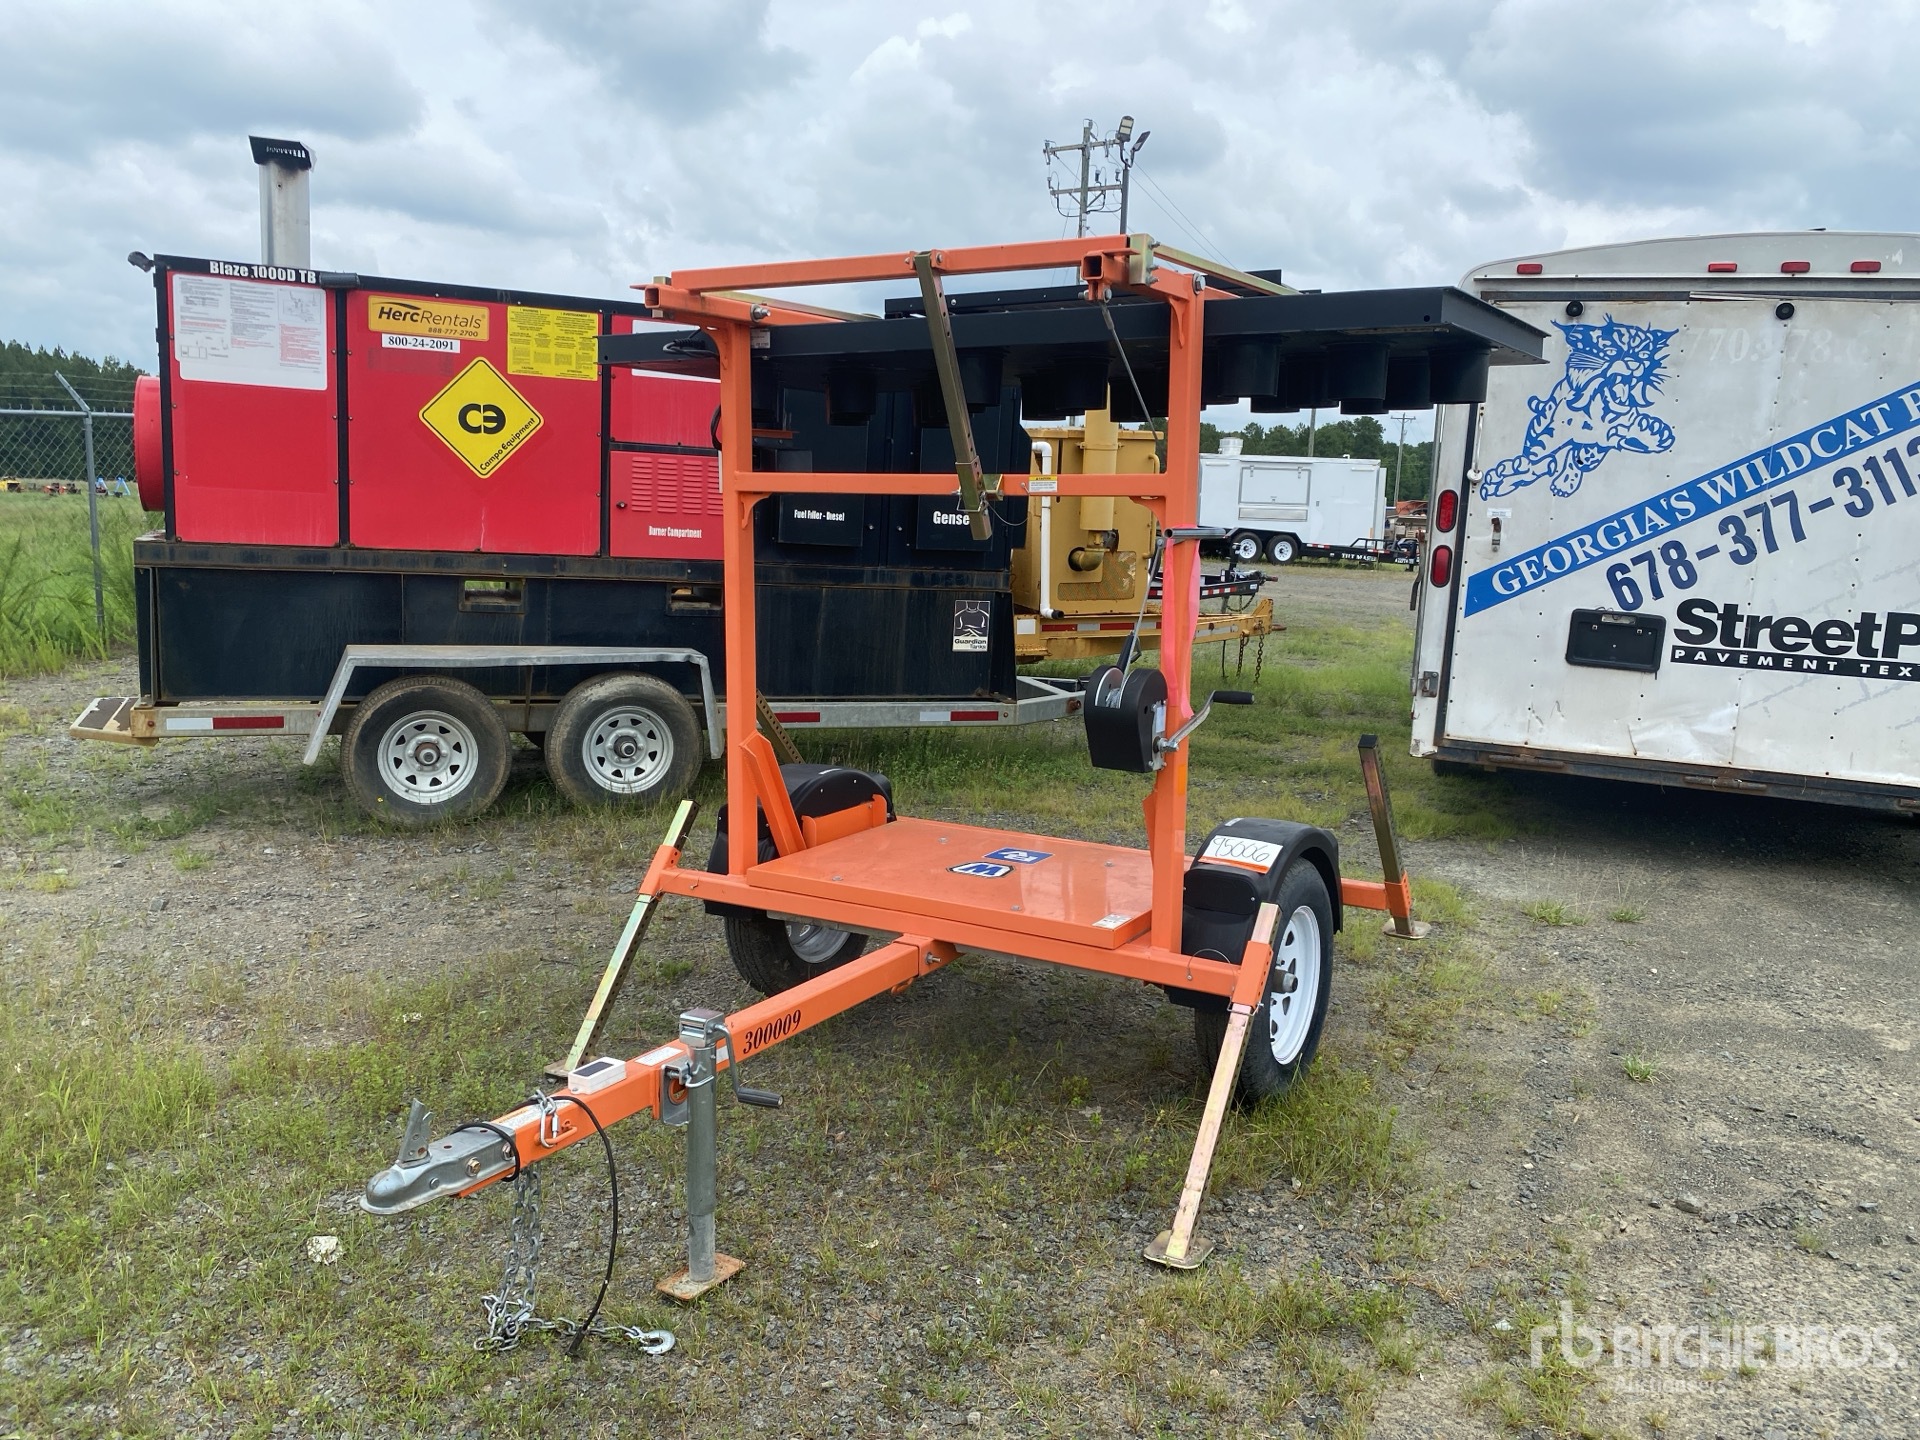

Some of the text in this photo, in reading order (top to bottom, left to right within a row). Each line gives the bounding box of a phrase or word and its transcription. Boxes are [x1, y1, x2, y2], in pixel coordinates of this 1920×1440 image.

[209, 260, 249, 277] Blaze
[298, 269, 317, 284] TB
[377, 306, 482, 329] HercRentals
[388, 335, 454, 351] 800-24-2091
[427, 327, 479, 337] 888-777-2700
[479, 417, 536, 471] Campo Equipment
[1490, 489, 1697, 597] GEORGIA'S
[1697, 402, 1894, 511] WILDCAT
[794, 509, 807, 519] Fuel
[826, 511, 845, 522] Diesel
[932, 510, 971, 526] Gense
[1673, 597, 1920, 660] StreetP
[1674, 649, 1920, 678] PAVEMENT TEX
[742, 1008, 802, 1054] 300009
